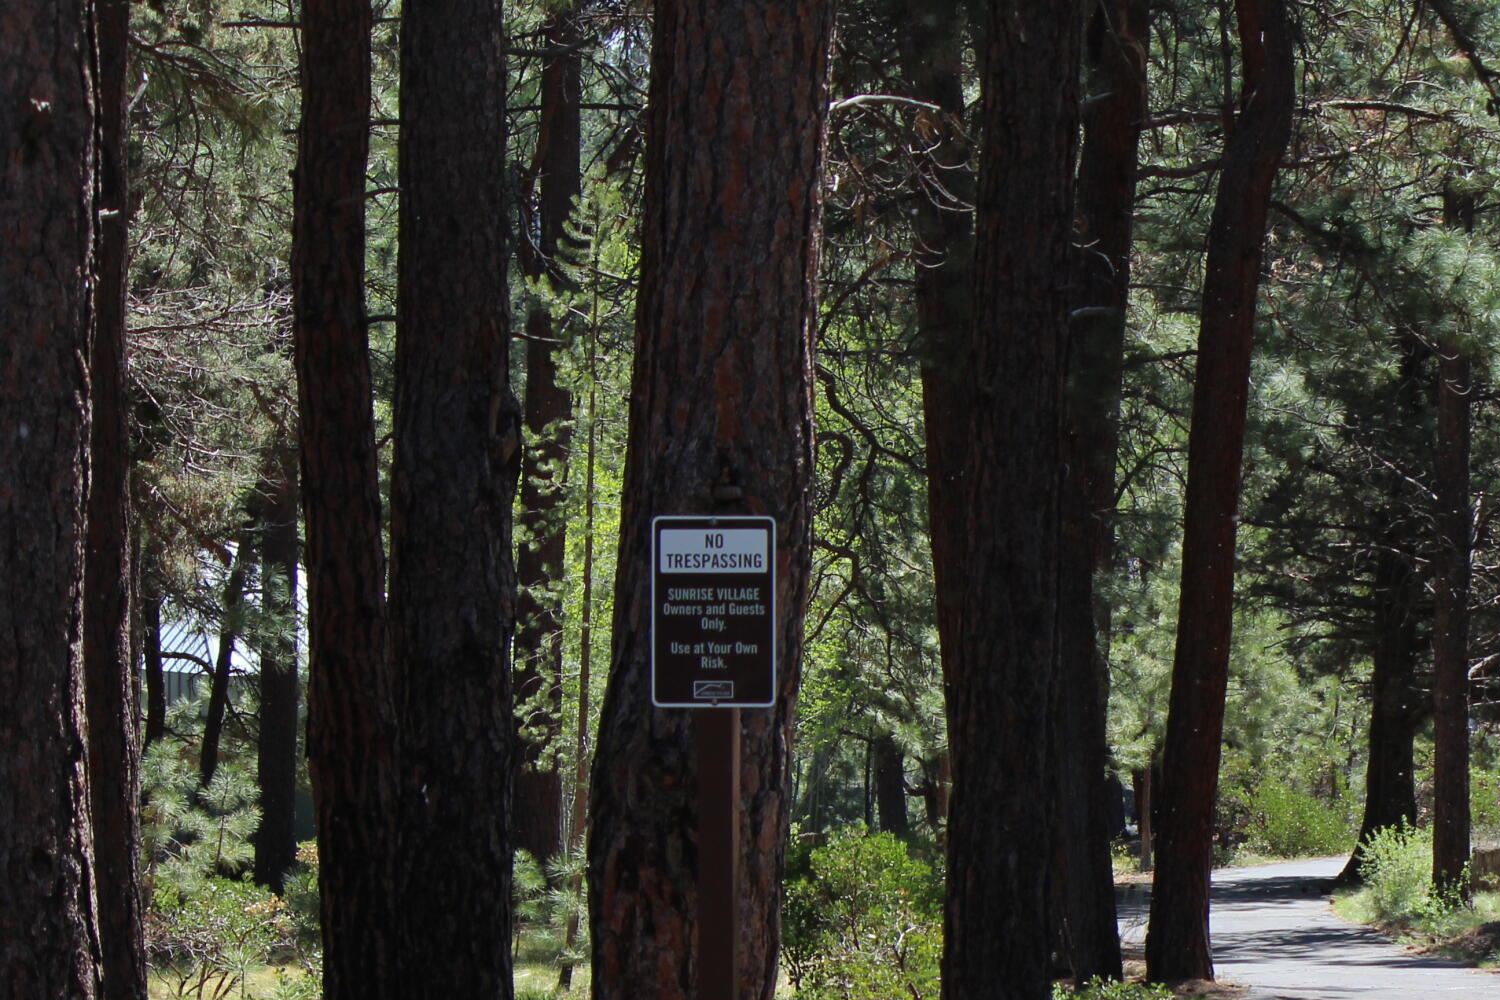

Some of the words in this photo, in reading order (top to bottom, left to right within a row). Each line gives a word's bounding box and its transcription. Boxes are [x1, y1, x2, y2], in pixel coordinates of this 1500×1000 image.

[704, 533, 724, 549] NO
[666, 553, 763, 569] TRESPASSING
[667, 588, 714, 601] SUNRISE
[716, 588, 760, 601] VILLAGE
[663, 603, 703, 616] Owners
[705, 603, 726, 616] and
[728, 603, 765, 616] Guests
[701, 617, 727, 632] Only.
[671, 642, 690, 655] Use
[693, 642, 705, 655] at
[708, 642, 732, 655] Your
[735, 642, 758, 655] Own
[701, 656, 727, 669] Risk.
